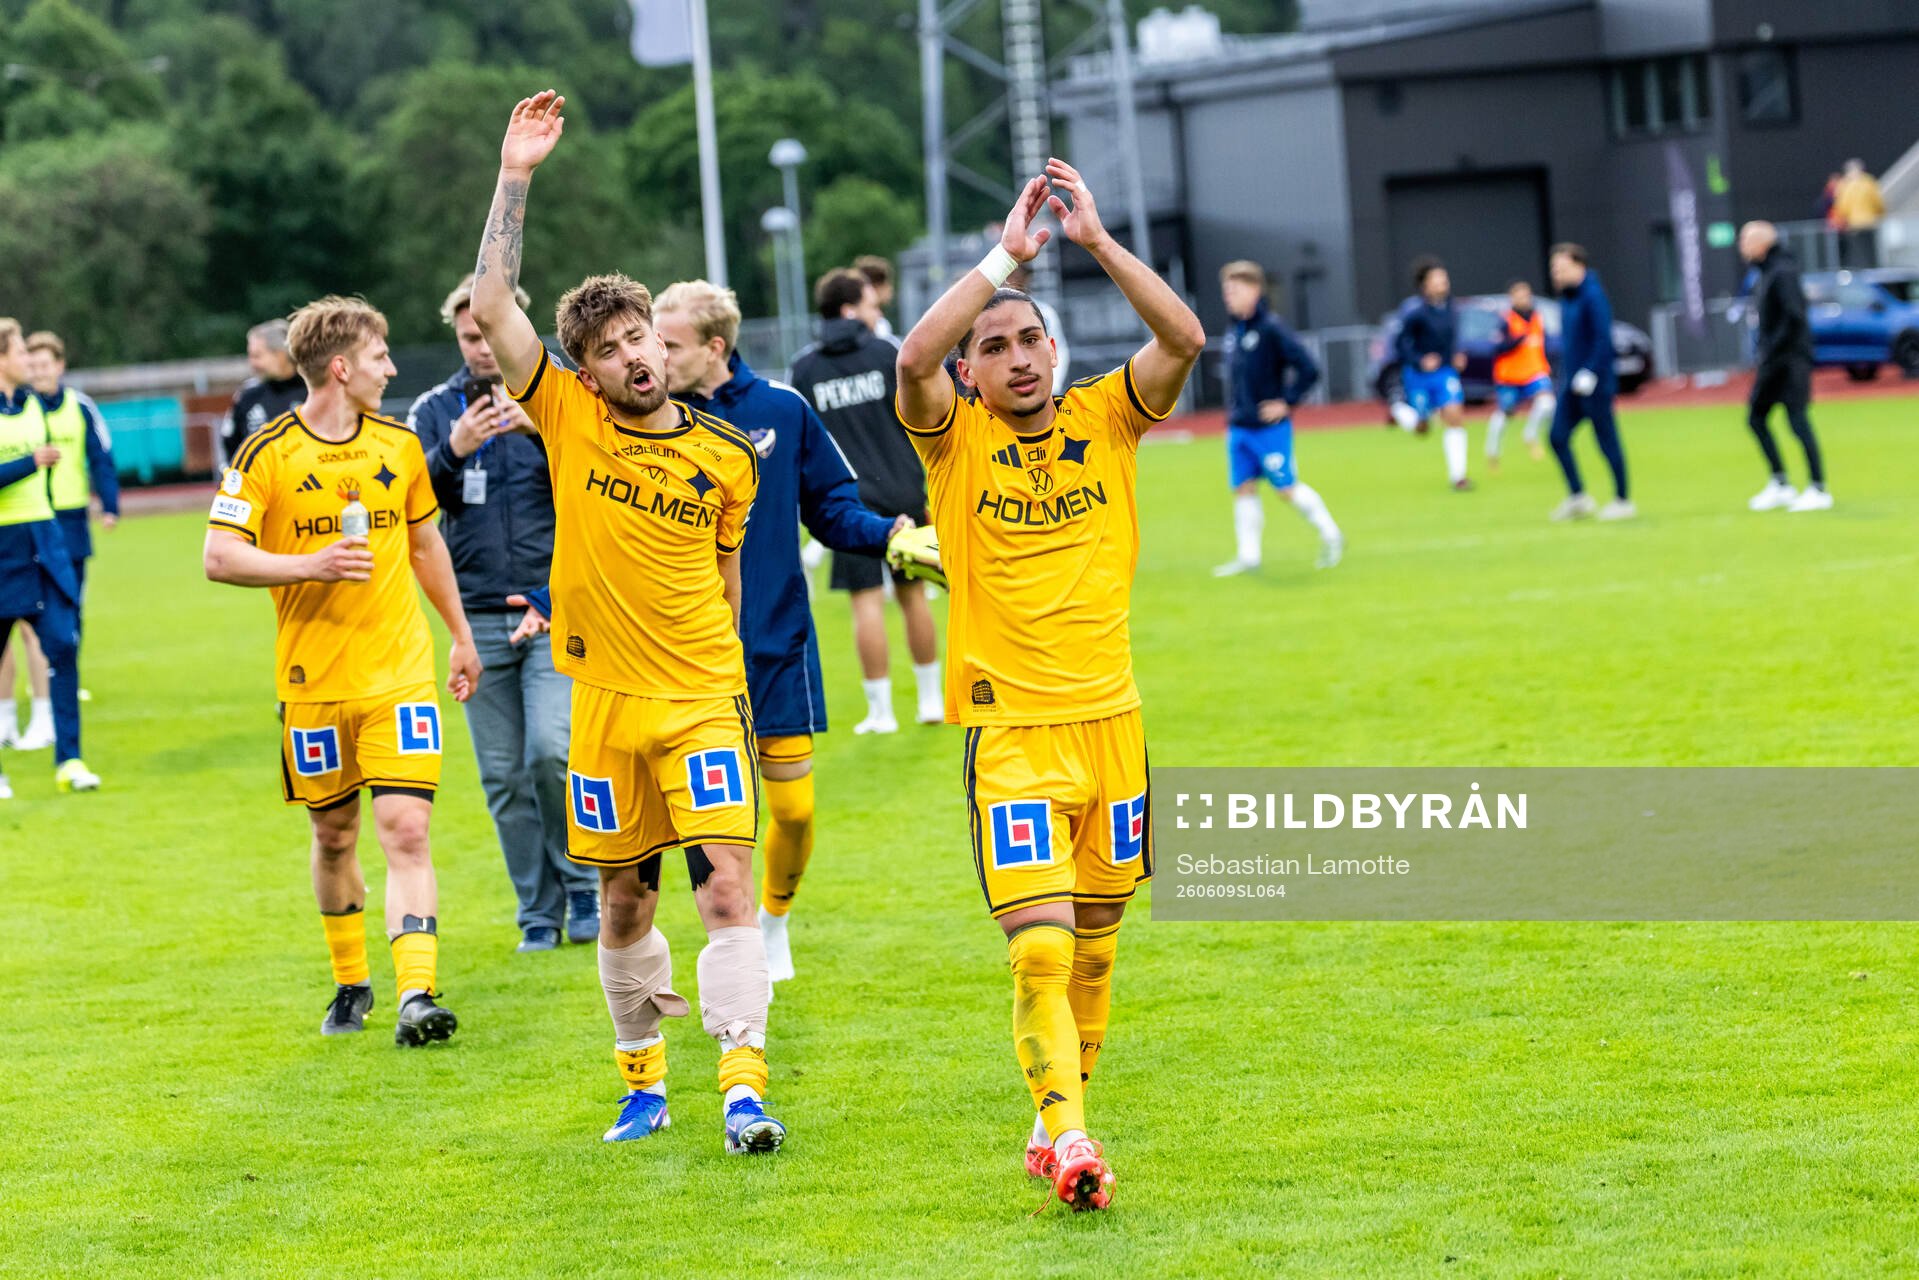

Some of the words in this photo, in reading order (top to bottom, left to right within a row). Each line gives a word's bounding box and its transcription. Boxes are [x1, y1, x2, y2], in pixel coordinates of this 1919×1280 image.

[1058, 406, 1072, 416] lia
[317, 449, 368, 464] stadium
[621, 444, 681, 459] stadium
[586, 469, 716, 529] HOLMEN
[976, 481, 1108, 526] HOLMEN
[294, 509, 401, 538] HOLEN
[1026, 1061, 1054, 1079] IFK
